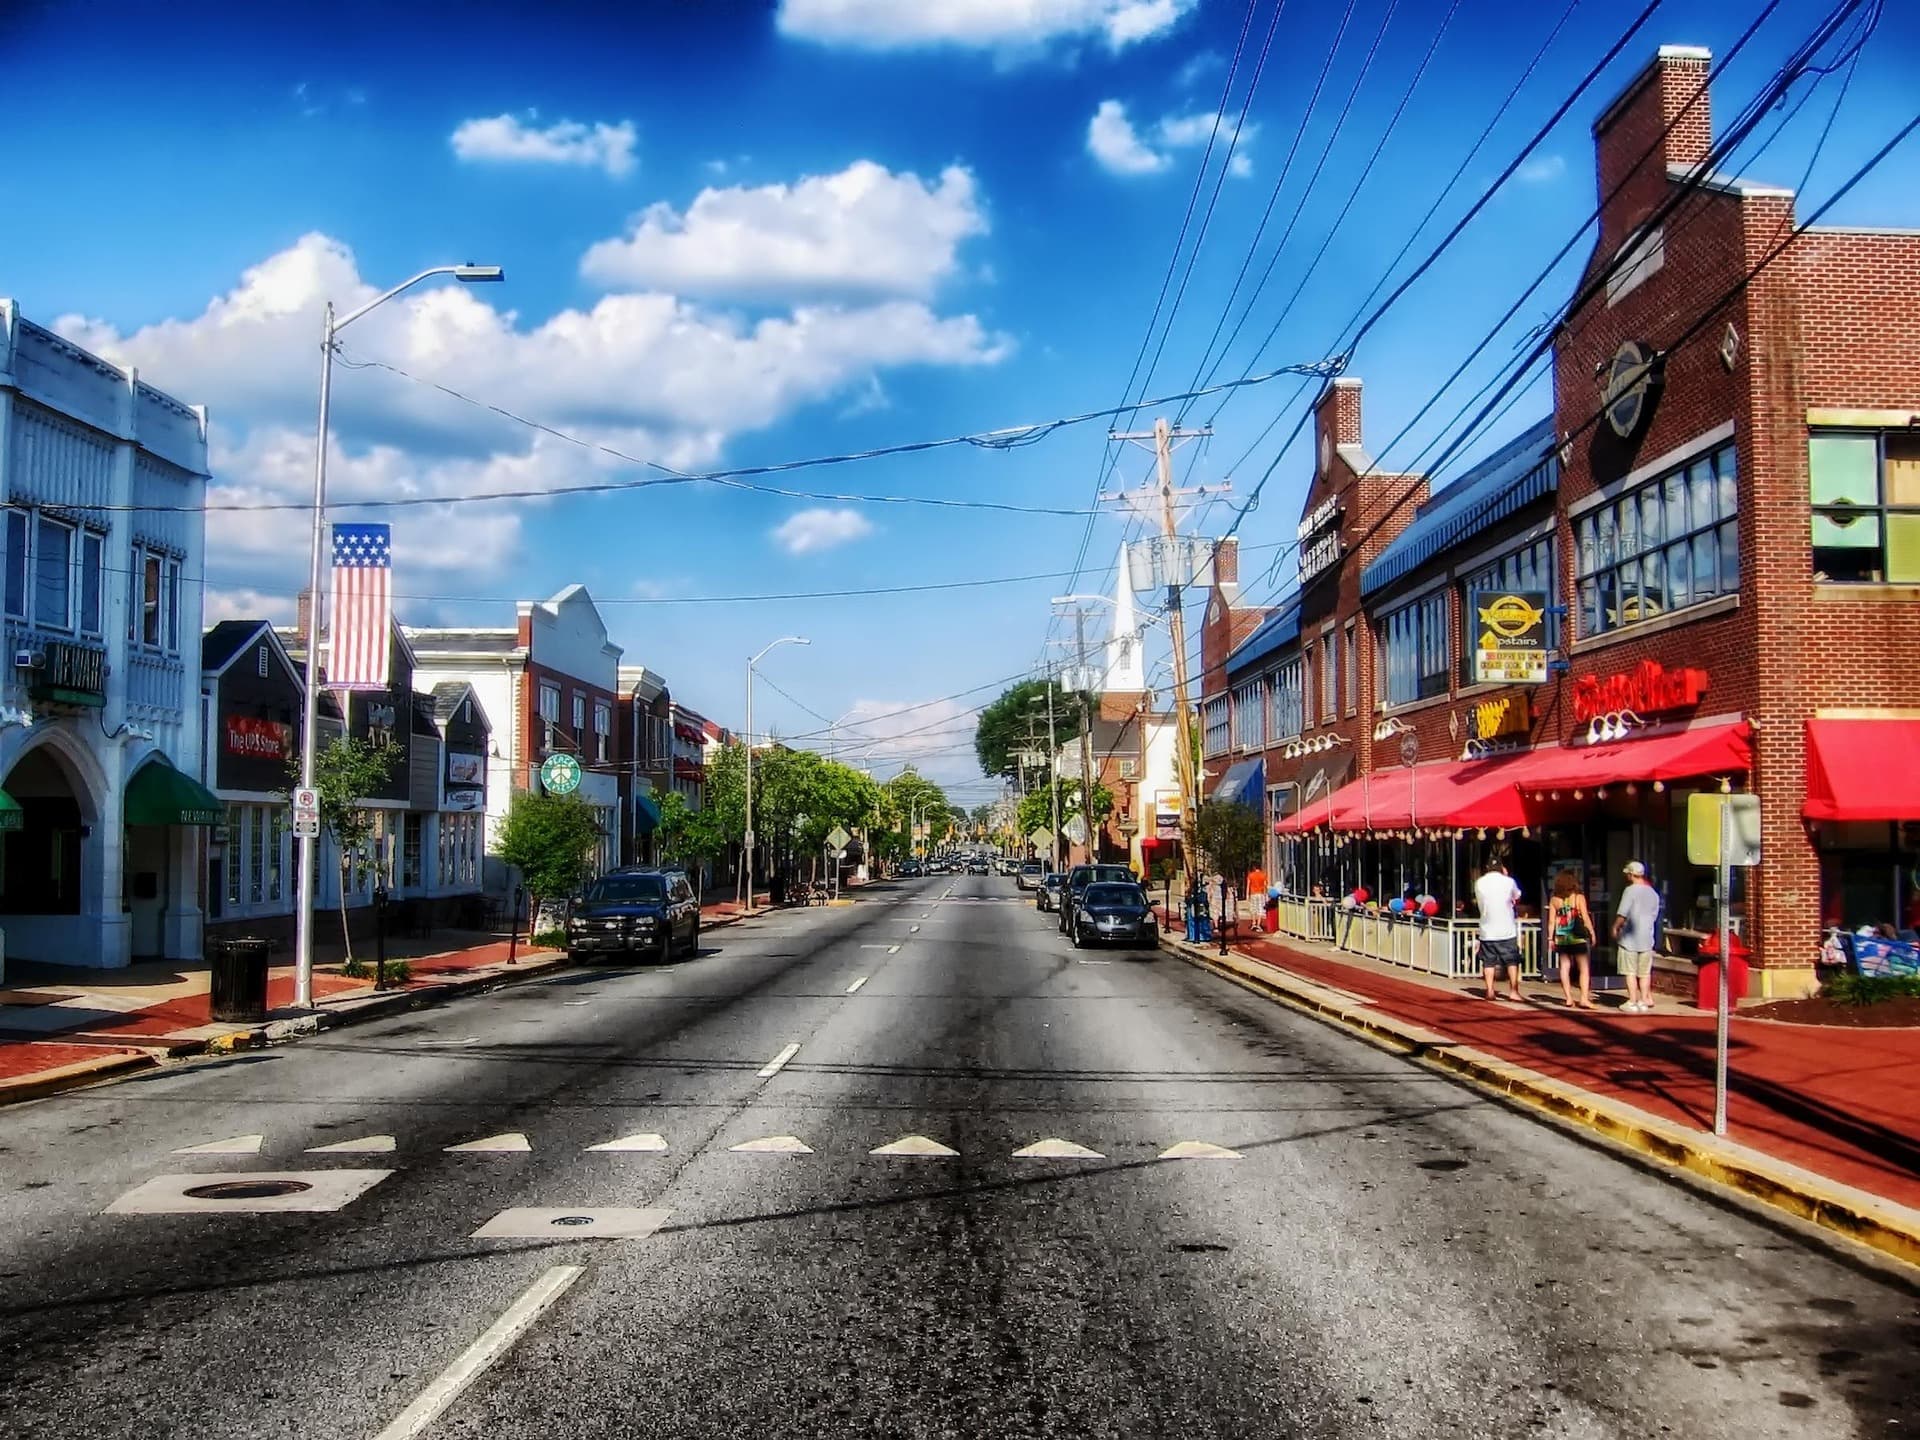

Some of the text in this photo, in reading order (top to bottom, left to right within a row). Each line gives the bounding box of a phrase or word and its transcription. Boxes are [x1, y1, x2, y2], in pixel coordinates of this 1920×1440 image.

[229, 729, 280, 753] The UPS Store
